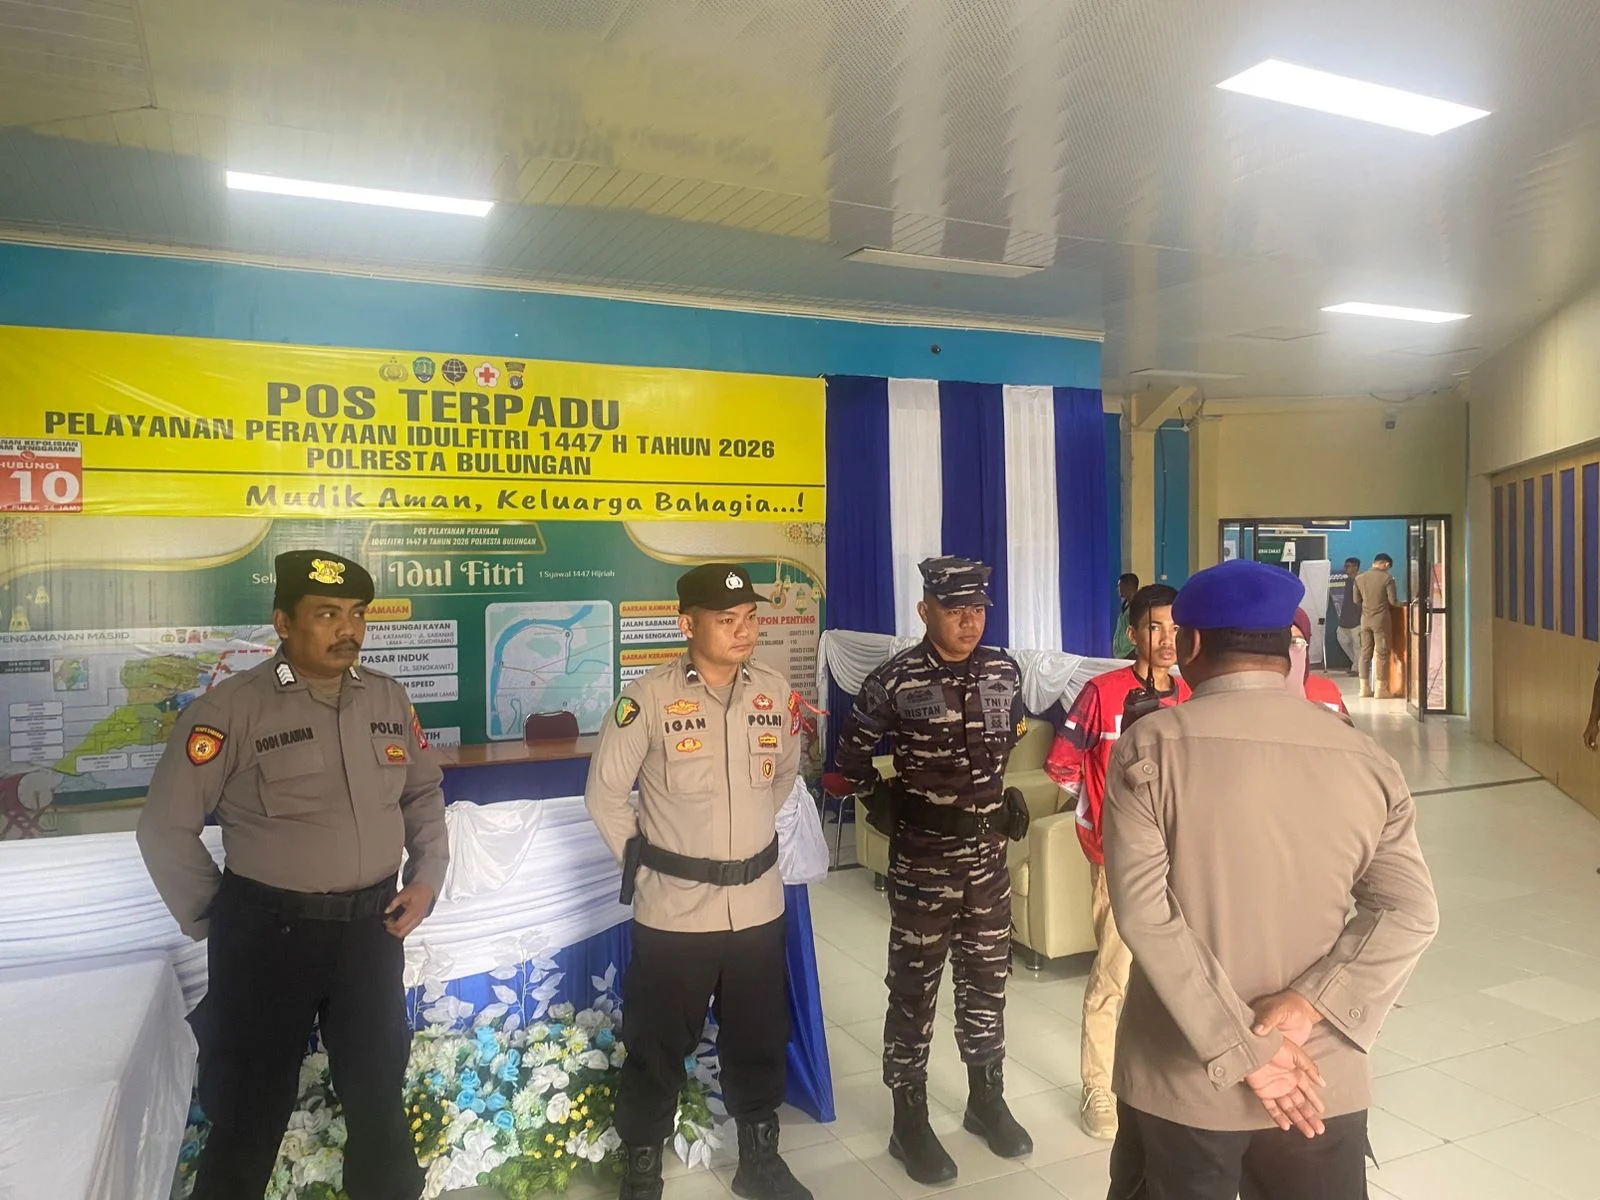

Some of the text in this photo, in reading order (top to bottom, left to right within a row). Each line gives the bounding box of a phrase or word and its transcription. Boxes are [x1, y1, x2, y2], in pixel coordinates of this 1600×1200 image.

[267, 381, 620, 431] POS TERPADU
[45, 411, 775, 459] PELAYANAN PERAYAAN IDULFITRI 1447 H TAHUN 2026
[307, 447, 591, 476] POLRESTA BULUNGAN
[9, 470, 80, 504] 10
[246, 484, 364, 508] Mudik
[377, 485, 483, 511] Aman,
[496, 488, 642, 514] Keluarga
[413, 527, 500, 535] POS PELAYANAN PERAYAAN
[429, 537, 451, 546] TAHUN
[453, 537, 469, 545] 2026
[470, 537, 501, 546] POLRESTA
[502, 537, 537, 546] BULUNGAN
[388, 559, 451, 588] Idul
[460, 560, 524, 587] Fitri
[544, 570, 571, 580] Syawal
[591, 569, 616, 578] Hijriah
[622, 619, 676, 628] JALAN SABANAR
[780, 615, 816, 624] PENTING
[366, 622, 451, 632] EPIAN SUNGAI KAYAN
[87, 631, 130, 641] MASJID
[361, 653, 430, 664] PASAR INDUK
[411, 680, 435, 688] SPEED
[747, 713, 782, 727] POLRI
[370, 721, 403, 736] POLRI
[425, 731, 440, 740] TIH
